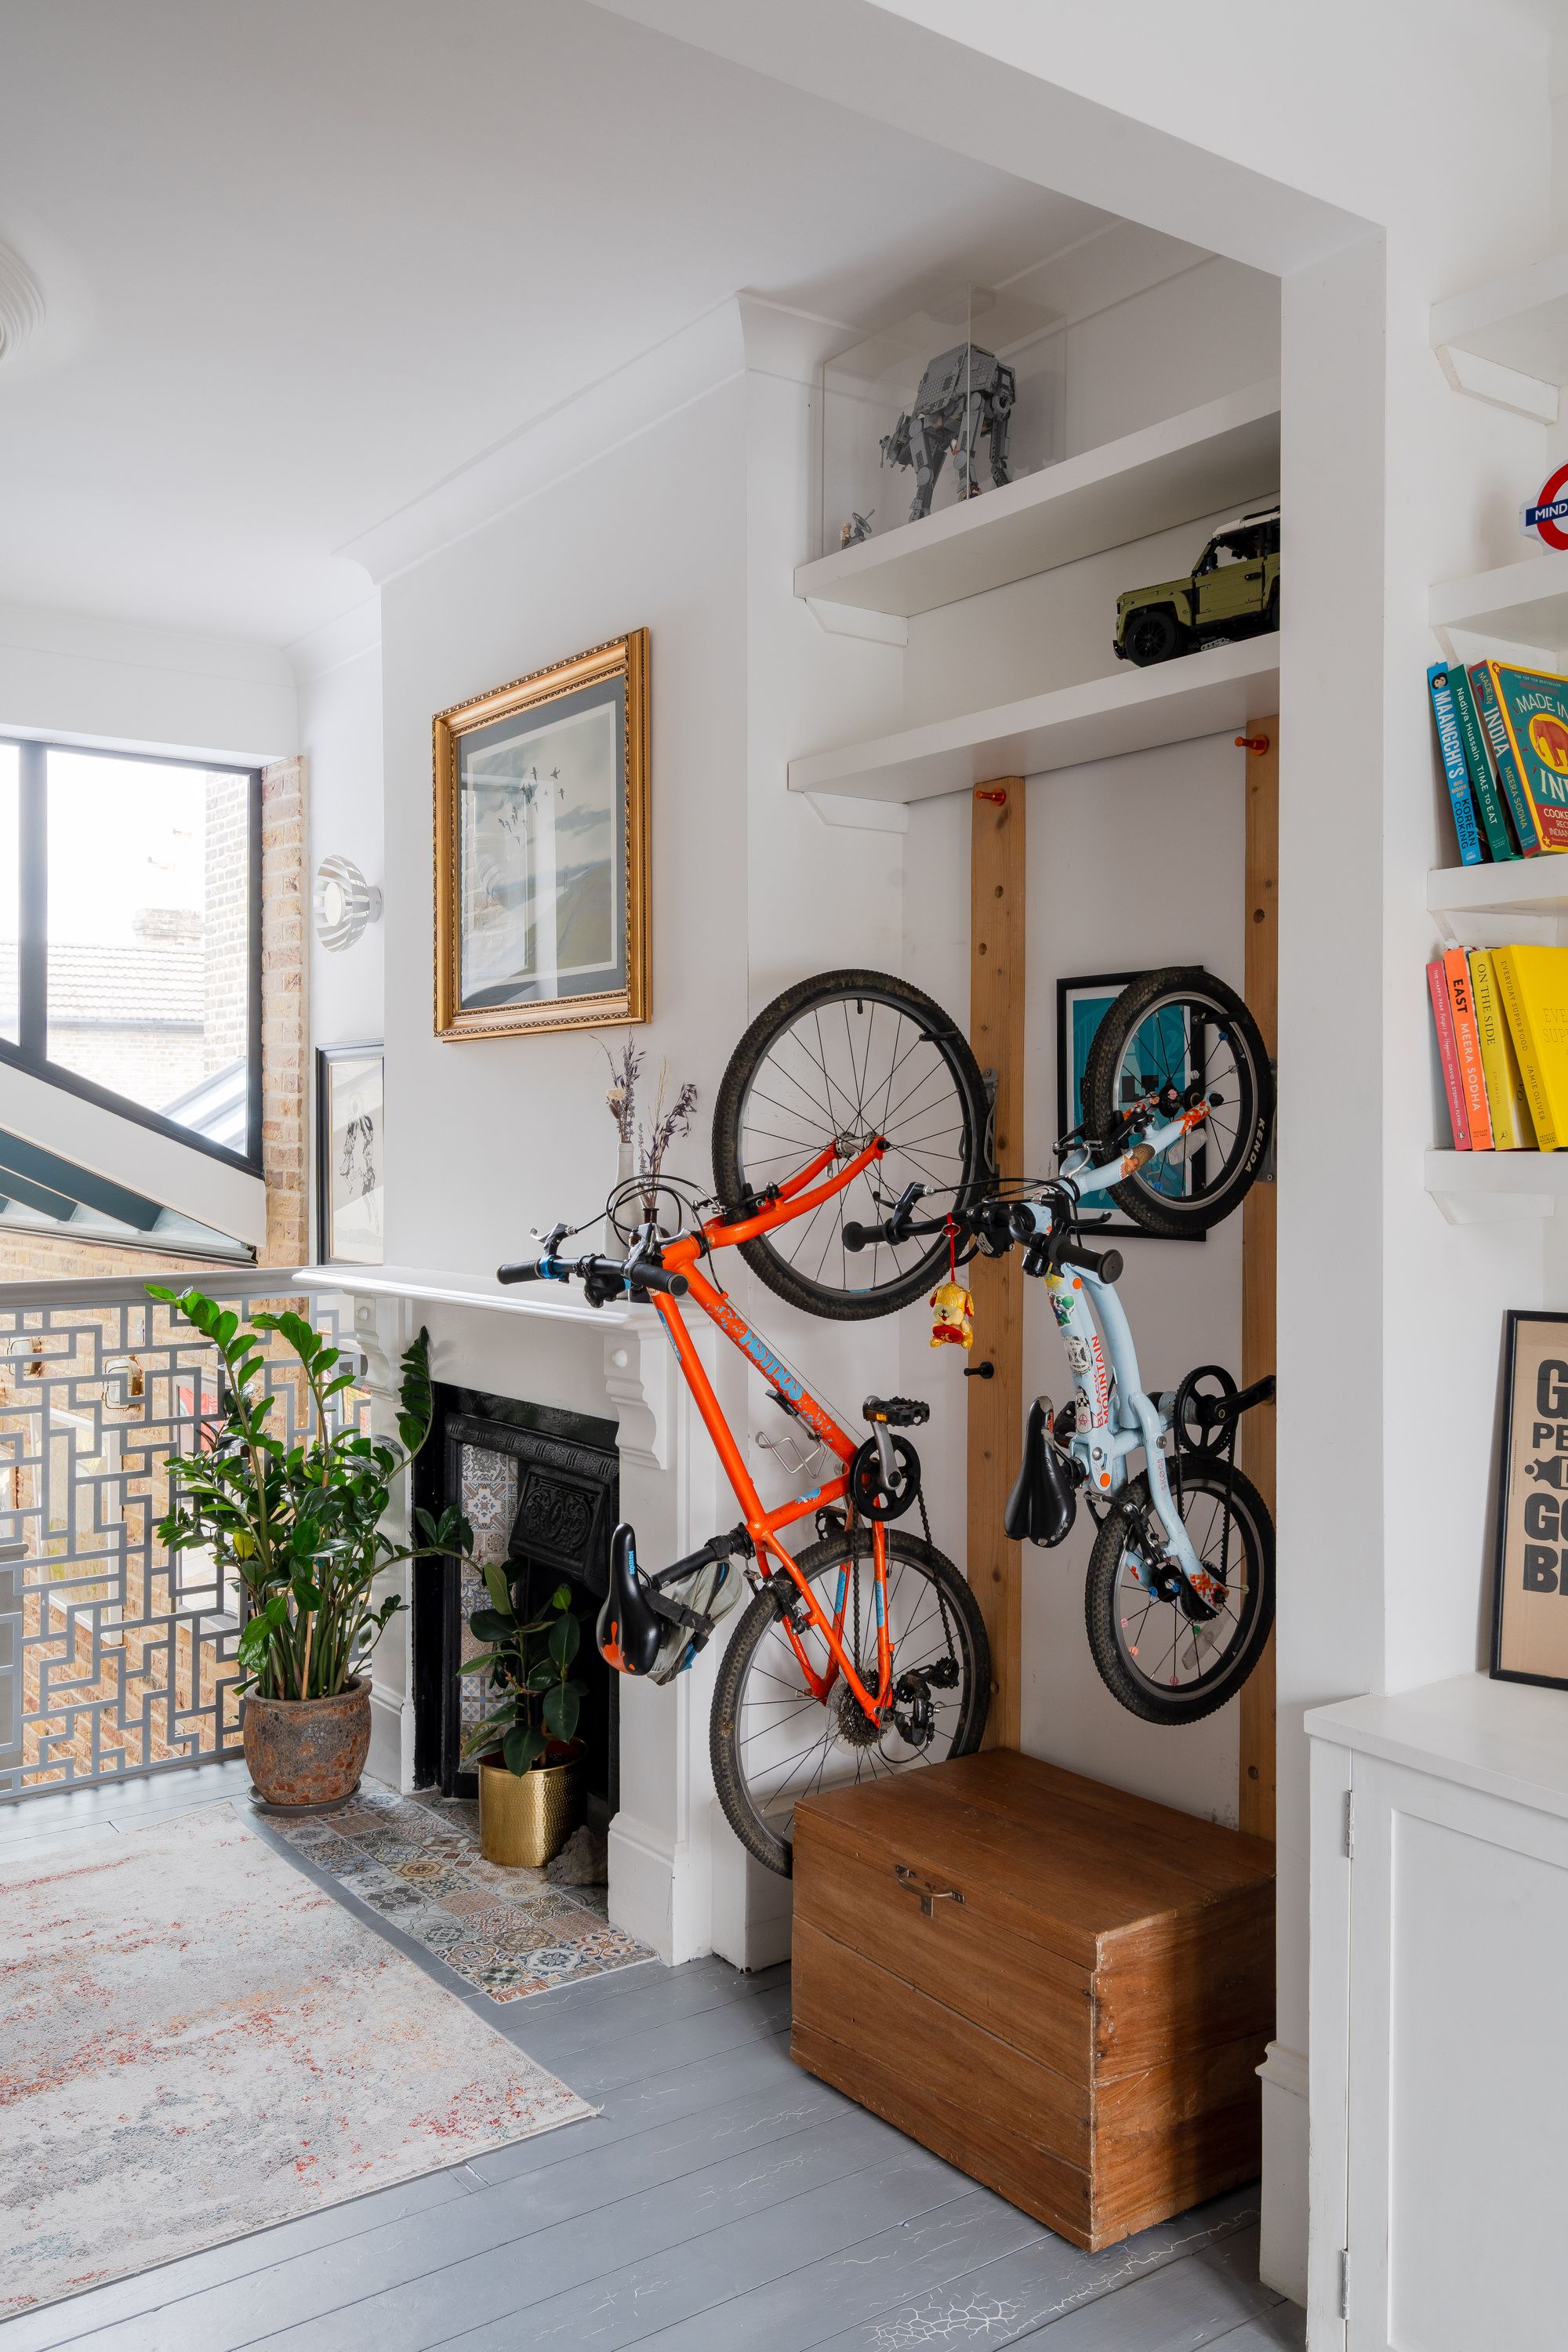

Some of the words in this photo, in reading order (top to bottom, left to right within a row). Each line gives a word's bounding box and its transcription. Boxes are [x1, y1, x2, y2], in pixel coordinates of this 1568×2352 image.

[1535, 503, 1568, 521] MIND
[1479, 671, 1493, 693] MADE
[1486, 695, 1493, 705] IN
[1457, 688, 1468, 721] Nadiya
[1466, 724, 1479, 760] Hussain
[1515, 693, 1555, 713] MADE
[1557, 701, 1568, 719] IN
[1435, 690, 1464, 779] MAANGCHI'S
[1484, 706, 1509, 758] INDIA
[1477, 765, 1488, 791] TIME
[1504, 767, 1517, 797] MEERA
[1514, 797, 1527, 829] SODHA
[1484, 793, 1491, 804] TO
[1486, 805, 1497, 824] EAT
[1454, 801, 1468, 849] COOKING
[1461, 798, 1476, 847] KOREAN
[1478, 964, 1487, 982] ON
[1454, 979, 1467, 1012] EAST
[1481, 985, 1490, 1013] THE
[1501, 961, 1516, 1000] EVERYDAY
[1512, 1004, 1523, 1027] SUPER
[1518, 1029, 1527, 1051] FOOD
[1543, 1008, 1568, 1022] EVE
[1461, 1023, 1474, 1063] MEERA
[1484, 1015, 1495, 1045] SIDE
[1543, 1029, 1568, 1042] SUP
[1467, 1068, 1480, 1111] SODHA
[1527, 1065, 1537, 1089] JAMIE
[1534, 1091, 1544, 1120] OLIVER
[1245, 1117, 1265, 1172] KENDA
[1091, 1334, 1108, 1425] MOUNTAIN
[1094, 1374, 1104, 1428] BLACK
[1523, 1492, 1568, 1542] G
